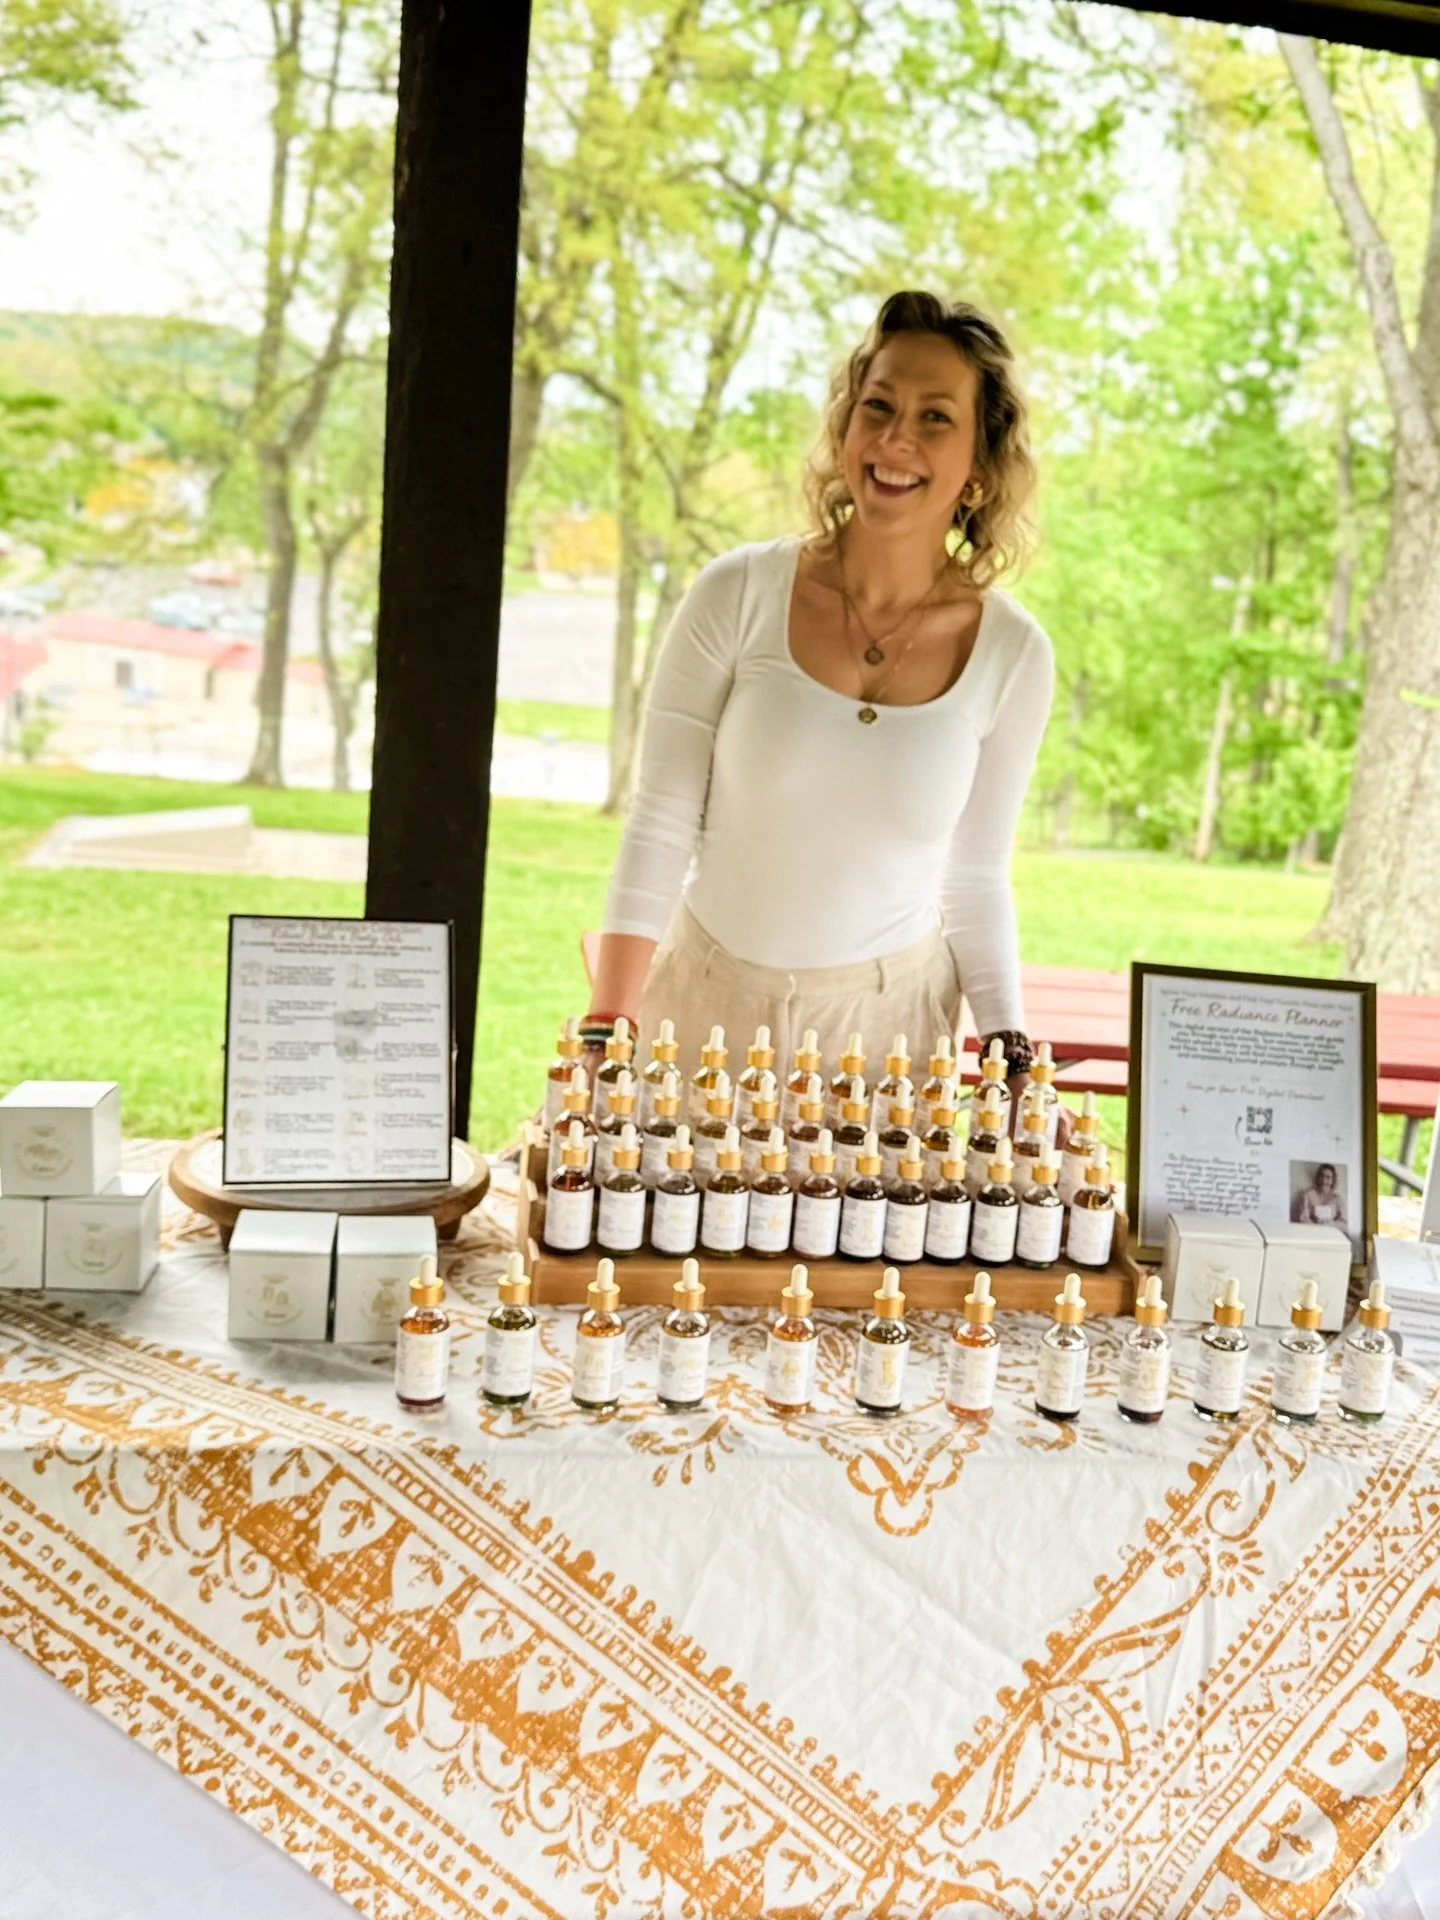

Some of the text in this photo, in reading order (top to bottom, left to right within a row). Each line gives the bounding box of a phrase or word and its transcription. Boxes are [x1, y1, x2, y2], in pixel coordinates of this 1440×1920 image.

[1170, 998, 1344, 1028] Free Radiance Planner
